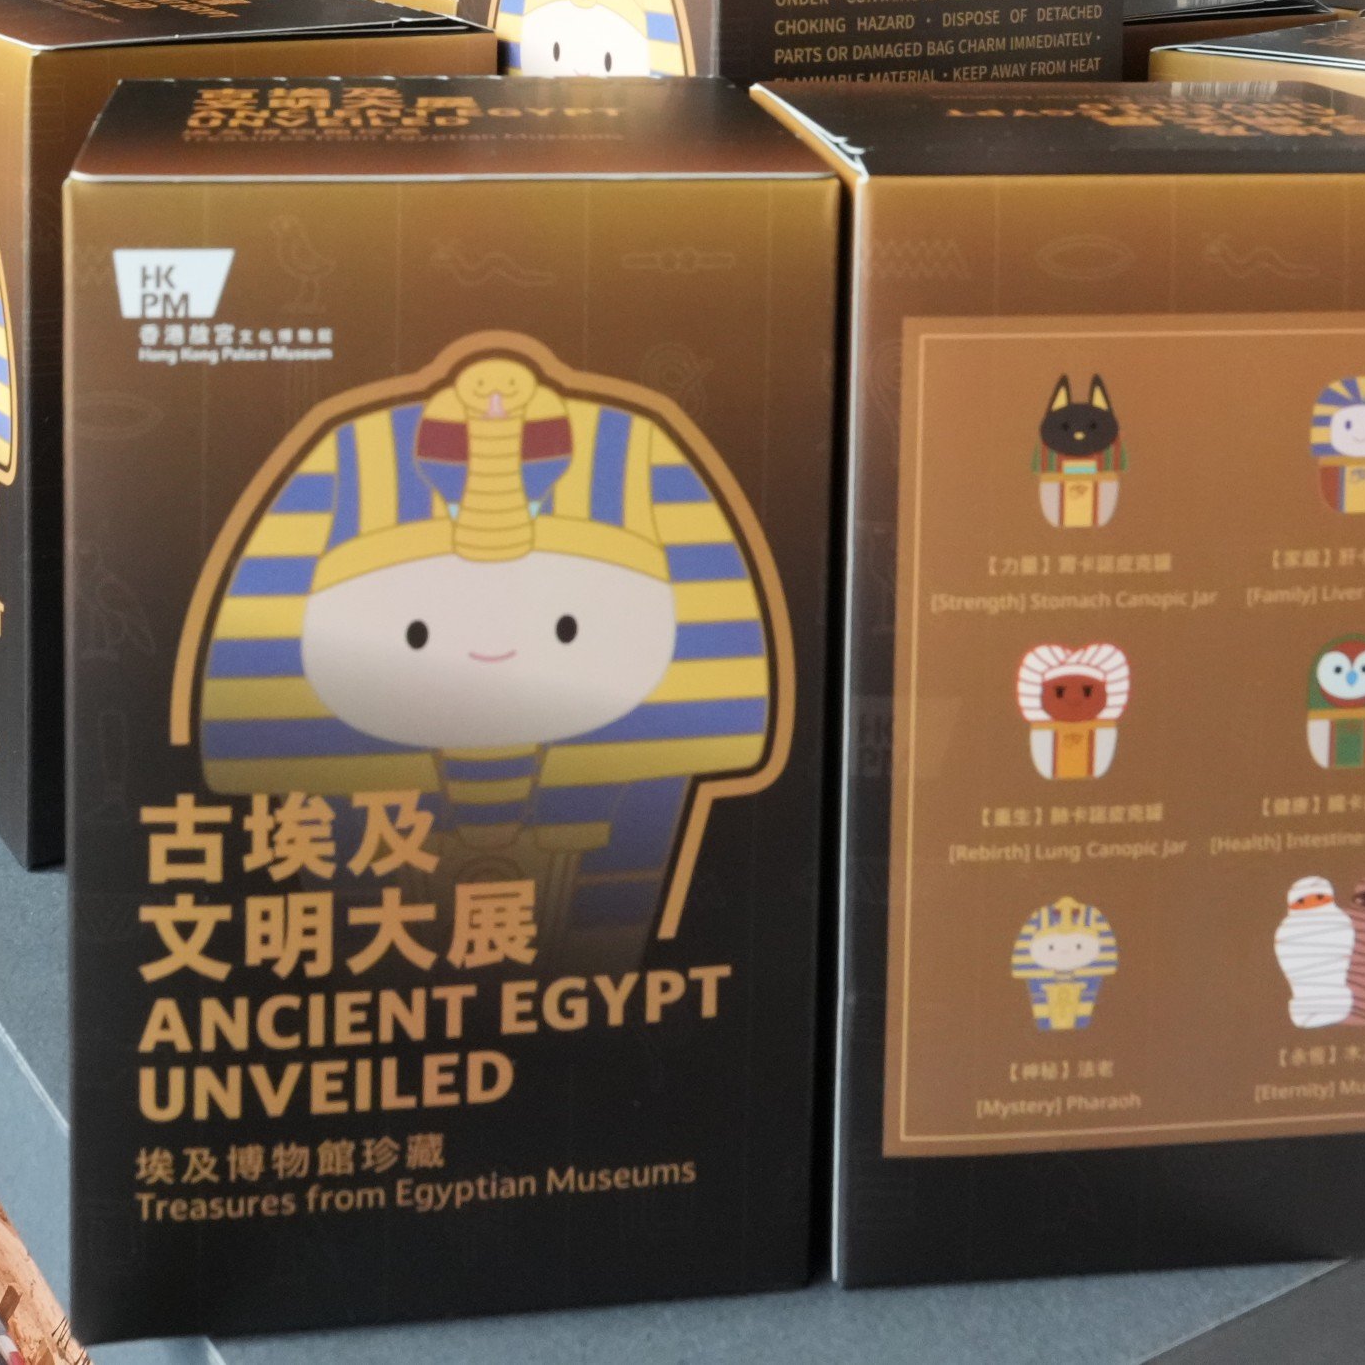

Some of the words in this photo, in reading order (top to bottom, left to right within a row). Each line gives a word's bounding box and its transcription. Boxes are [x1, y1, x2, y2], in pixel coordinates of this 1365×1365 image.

[140, 265, 175, 289] HK
[140, 292, 190, 319] PM
[138, 346, 178, 366] Hong
[180, 346, 220, 365] Kong
[221, 346, 269, 362] Palace
[270, 346, 334, 361] Museum
[139, 790, 438, 884] 古埃及
[139, 880, 537, 984] 文明大展
[138, 984, 477, 1053] ANCIENT
[501, 964, 732, 1034] EGYPT
[139, 1051, 514, 1121] UNVEILED
[136, 1133, 446, 1186] 埃及博物館珍藏
[135, 1178, 296, 1221] Treasures
[305, 1176, 386, 1213] from
[396, 1171, 536, 1210] Egyptian
[547, 1161, 696, 1195] Museums
